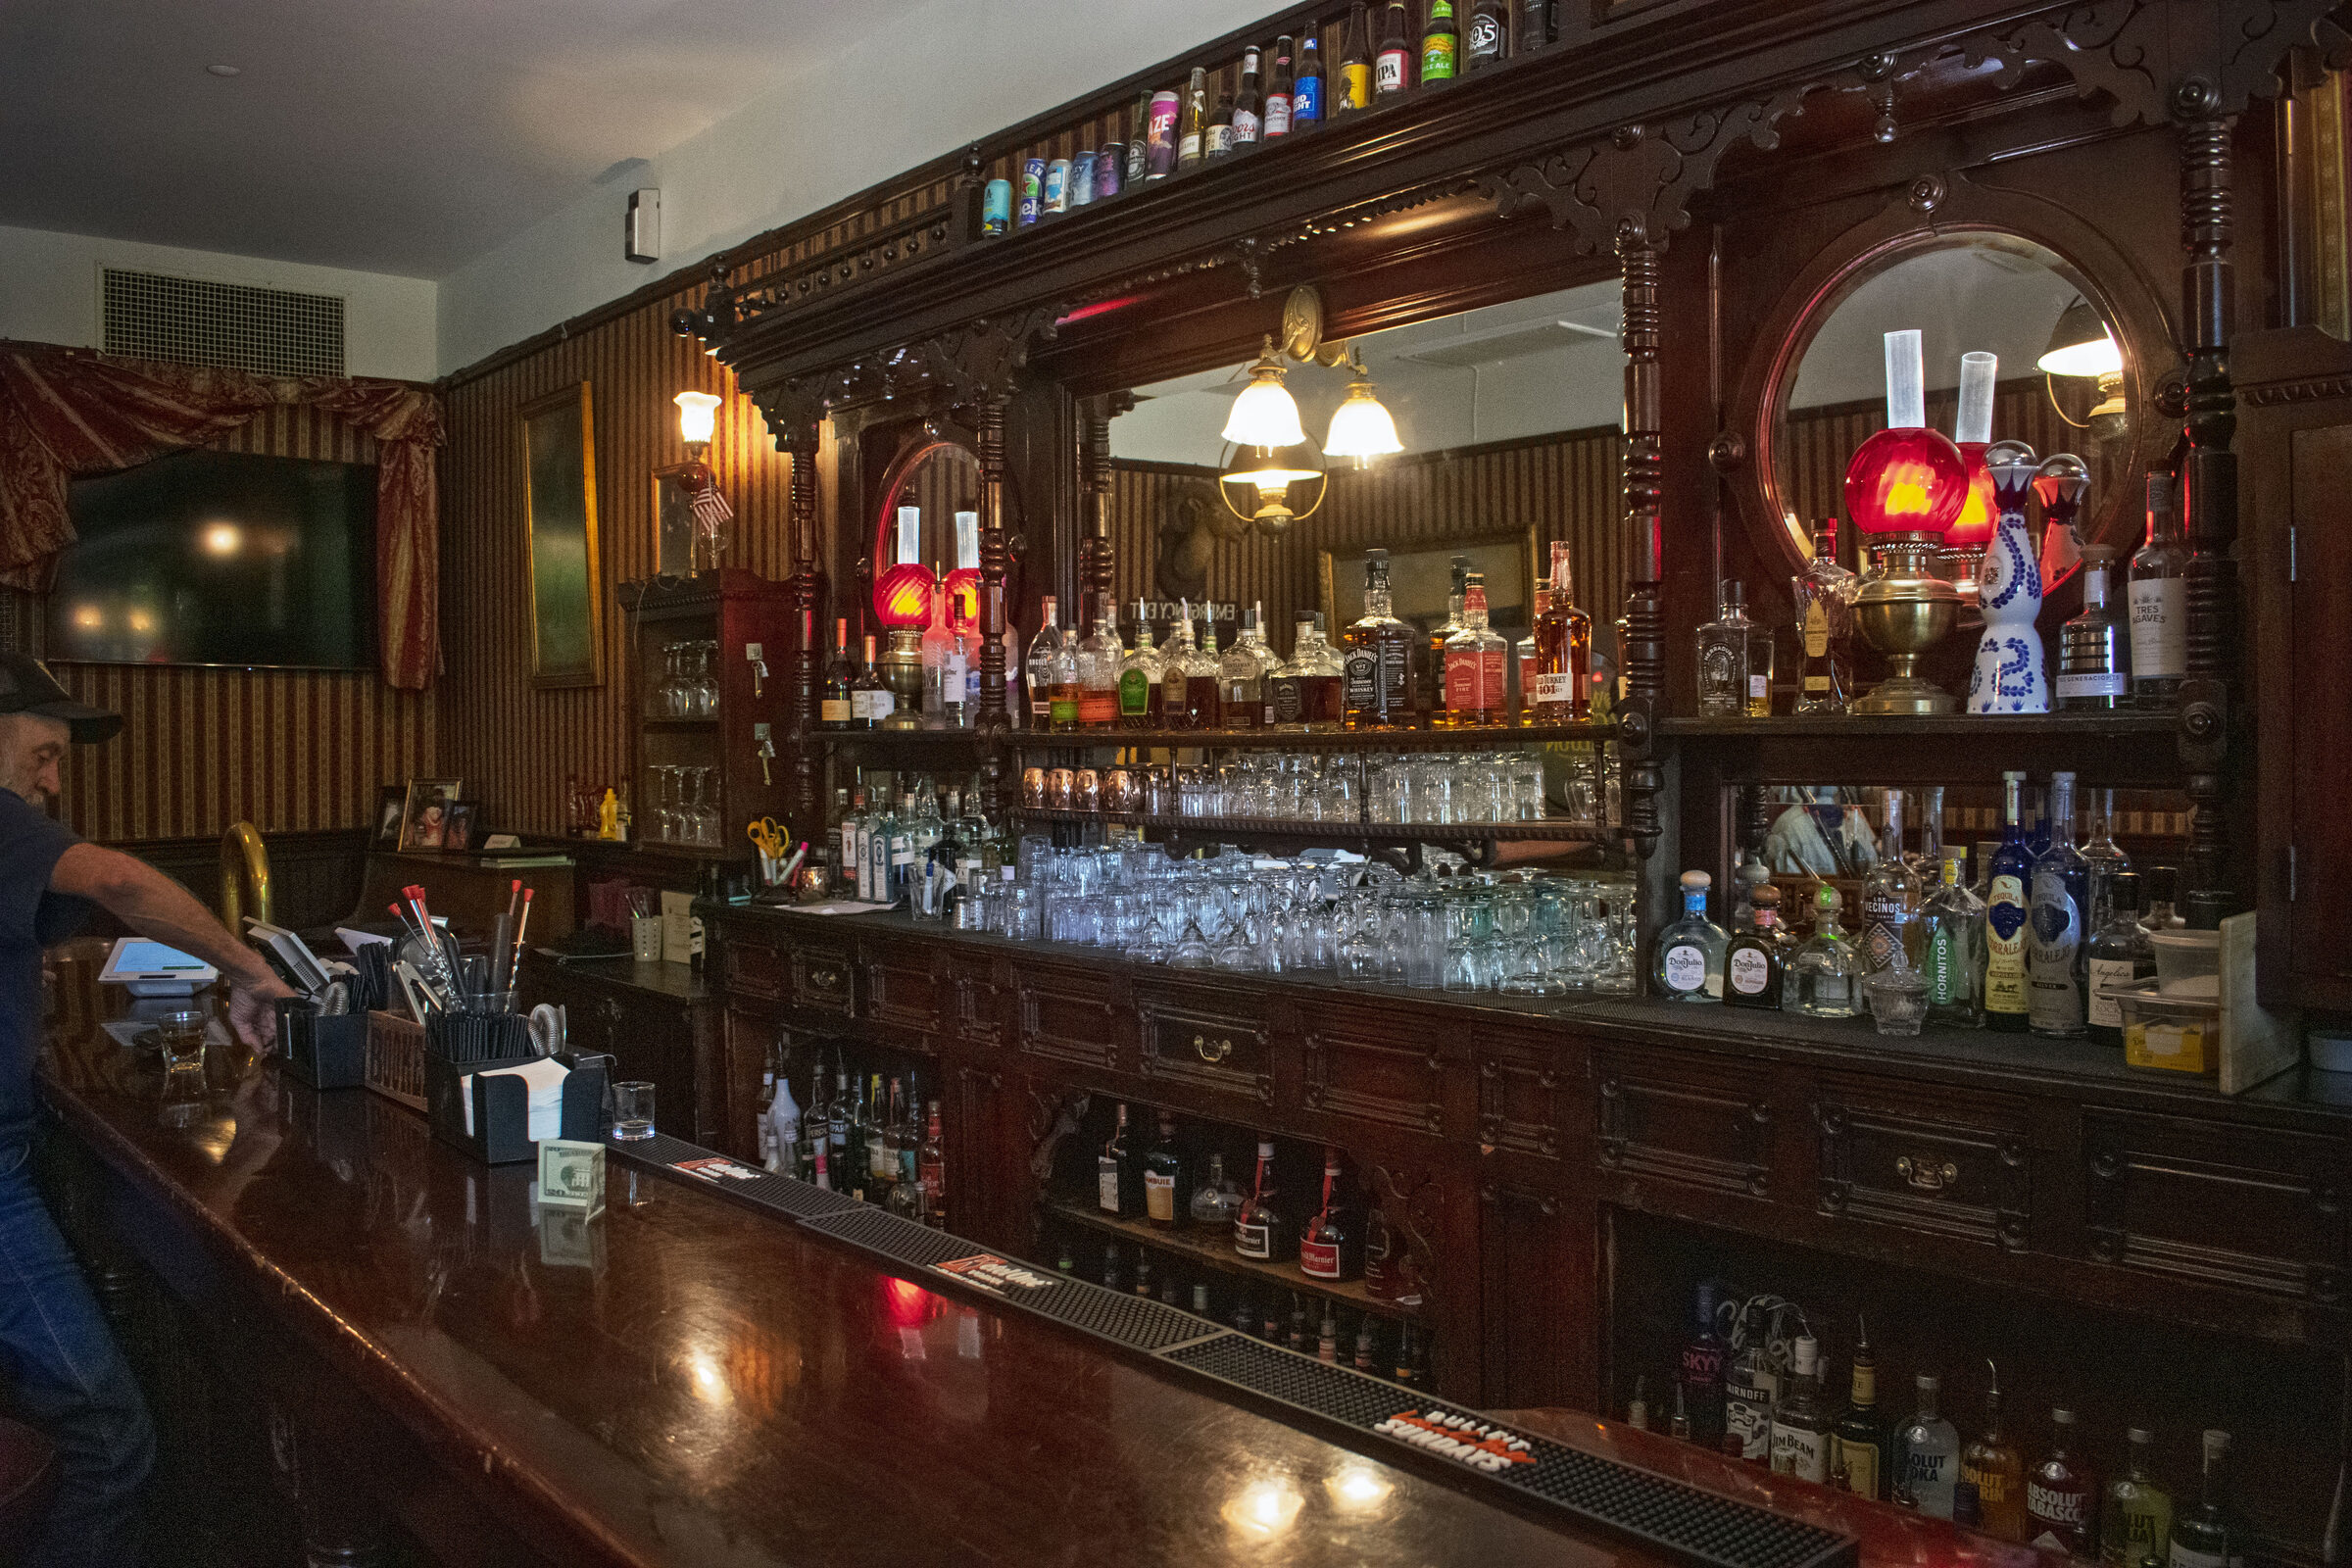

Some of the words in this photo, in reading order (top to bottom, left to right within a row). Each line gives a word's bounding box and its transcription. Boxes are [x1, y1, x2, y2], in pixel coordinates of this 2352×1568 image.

[1377, 64, 1396, 82] IPA
[2132, 614, 2167, 623] AGAVES
[1346, 651, 1358, 665] JACK
[1356, 648, 1379, 663] DANIEL'S
[1703, 645, 1736, 662] HERRADURA
[1447, 661, 1459, 672] JACK
[1544, 674, 1567, 683] TURKEY
[1539, 684, 1556, 695] 101
[1993, 892, 2020, 904] TEQUILA
[1936, 938, 1947, 1001] HORNITOS
[1683, 1350, 1723, 1373] SKYY
[1772, 1433, 1786, 1448] JIM
[1787, 1434, 1815, 1459] BEAM
[2028, 1481, 2085, 1507] ABSOLUT
